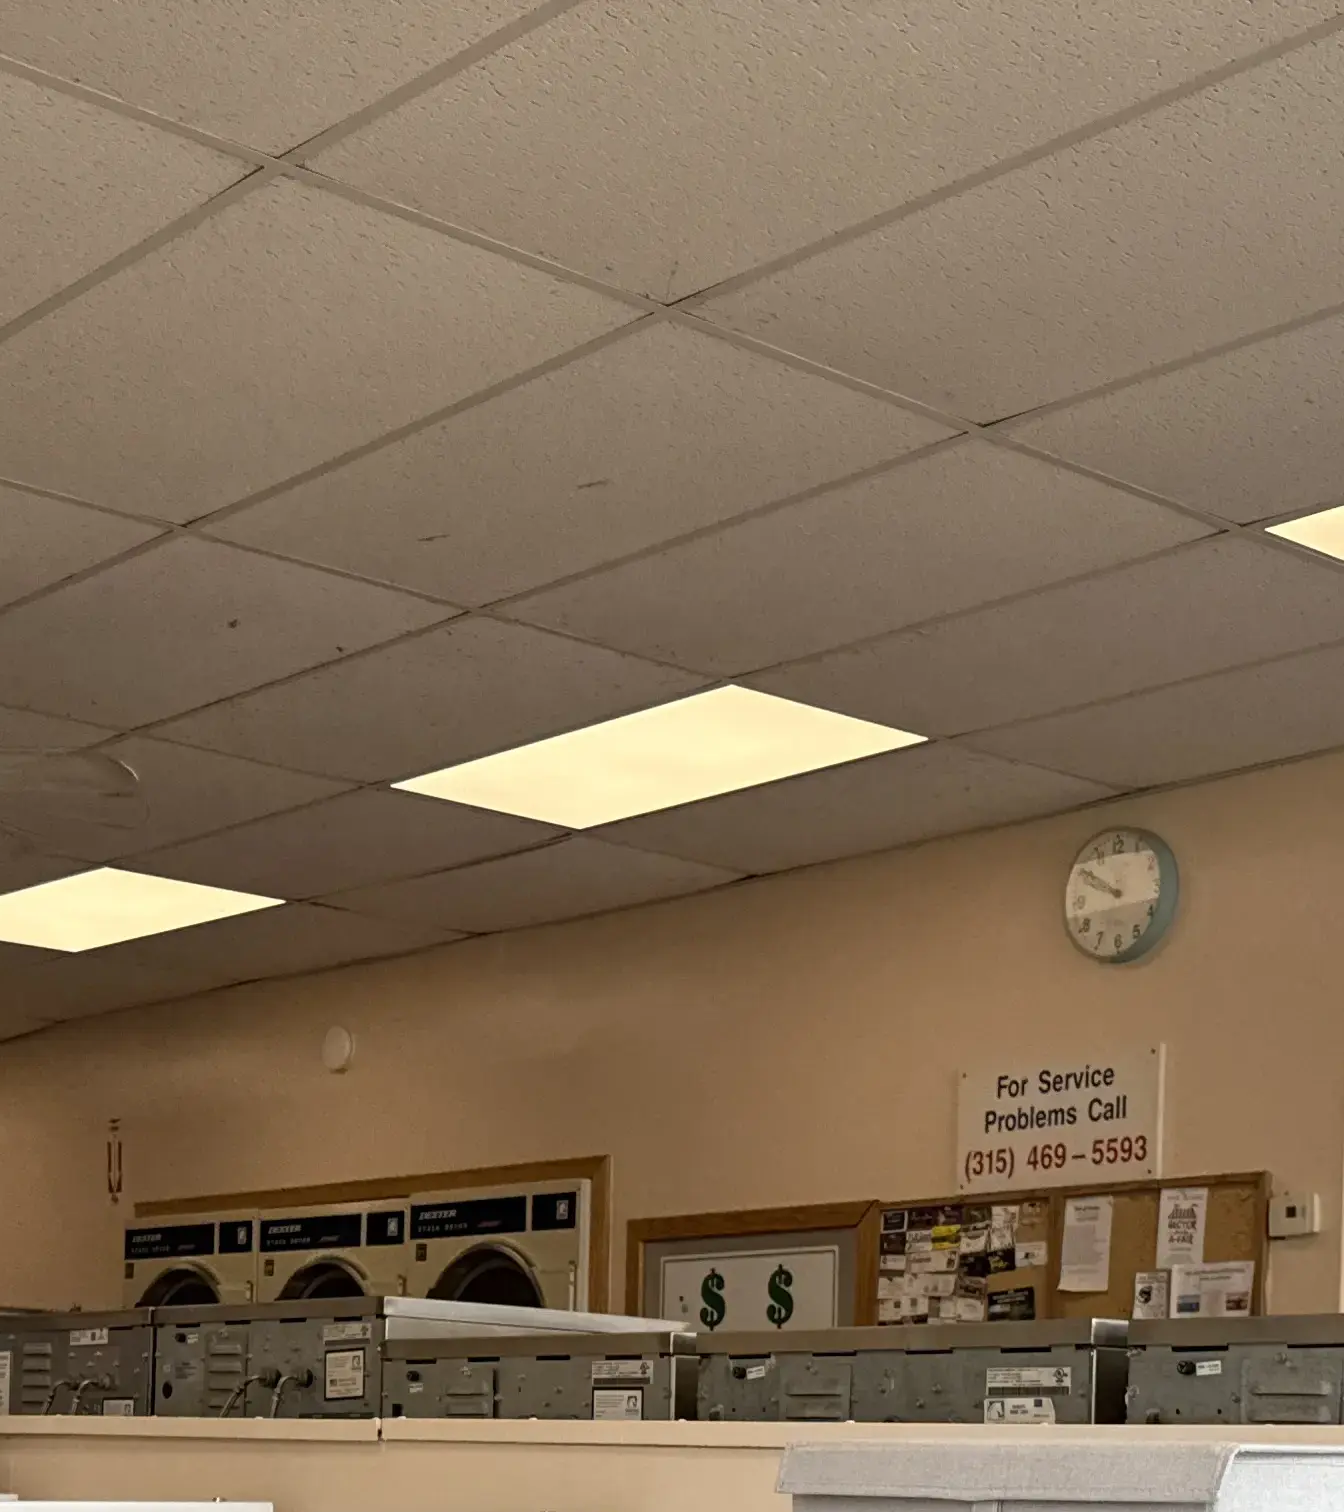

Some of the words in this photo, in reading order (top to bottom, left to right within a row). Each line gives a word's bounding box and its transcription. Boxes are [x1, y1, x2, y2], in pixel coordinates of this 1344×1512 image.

[1132, 924, 1141, 939] 5
[996, 1074, 1028, 1099] For
[1039, 1066, 1115, 1095] Service
[985, 1103, 1077, 1134] Problems
[1088, 1096, 1128, 1122] Call
[964, 1146, 1015, 1183] (315)
